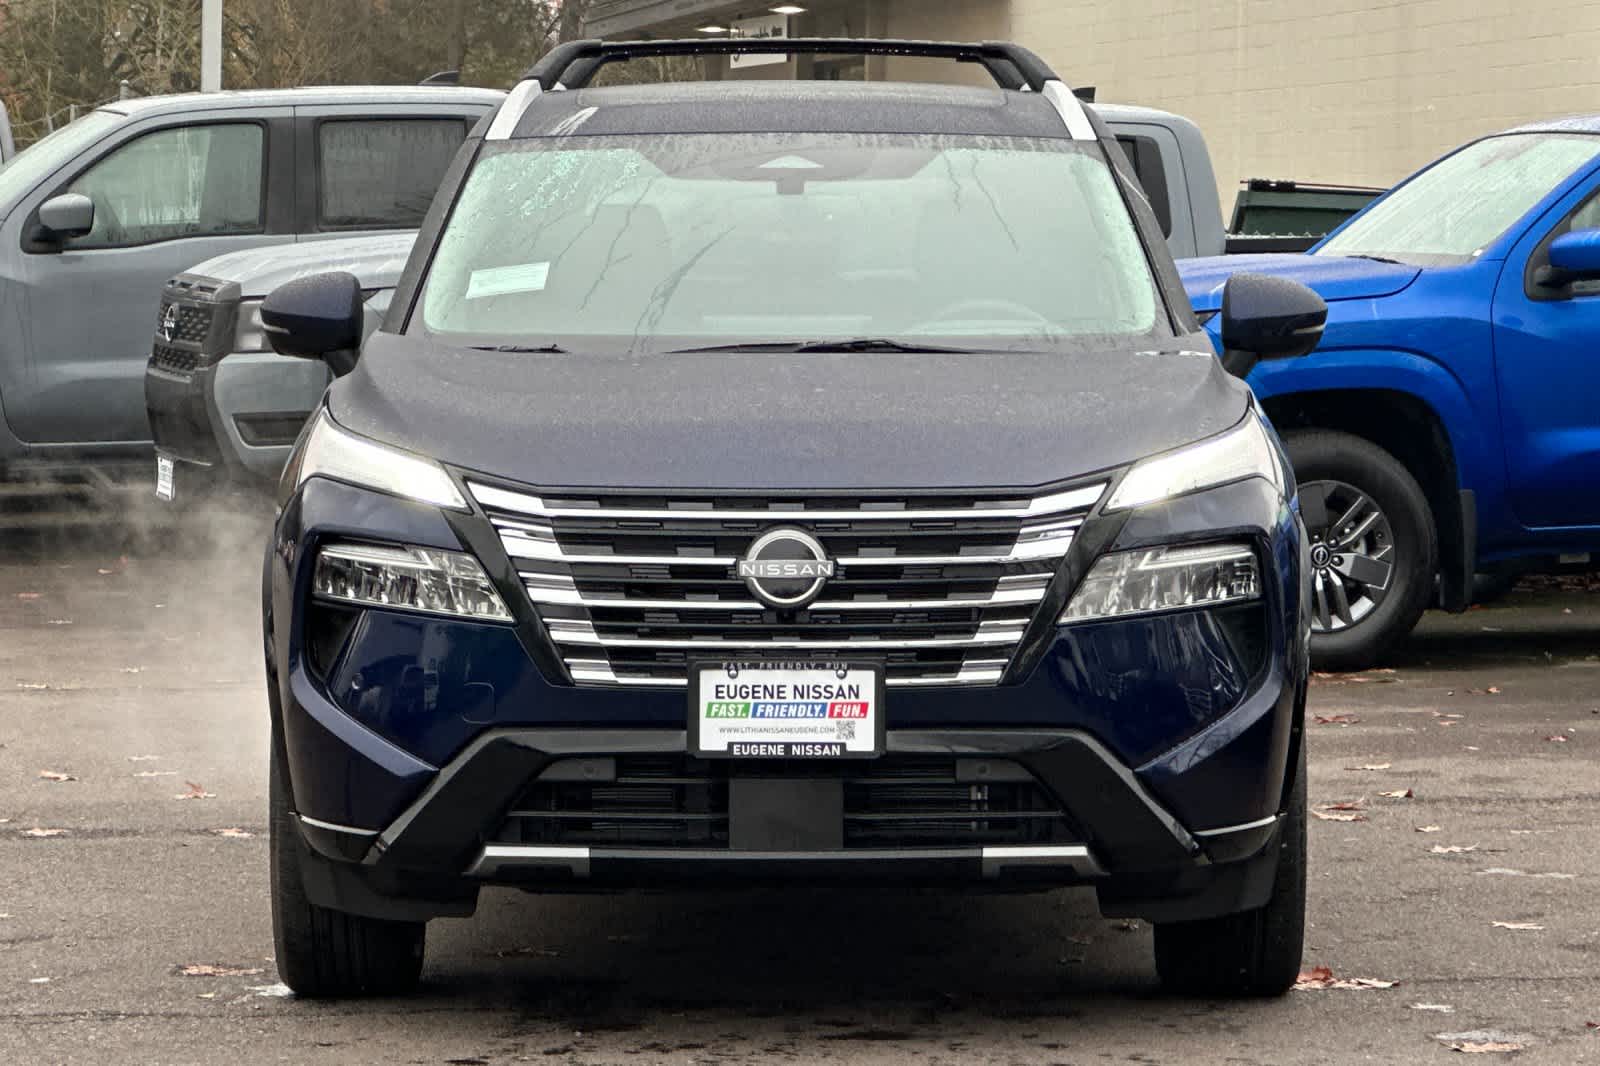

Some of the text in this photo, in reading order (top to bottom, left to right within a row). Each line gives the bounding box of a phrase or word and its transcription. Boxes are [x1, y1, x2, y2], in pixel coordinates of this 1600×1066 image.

[742, 564, 831, 576] NISSAN
[715, 684, 860, 700] EUGENE NISSAN
[710, 704, 865, 717] FAST. FRIENDLY. FUN.
[733, 744, 841, 756] EUGENE NISSAN
